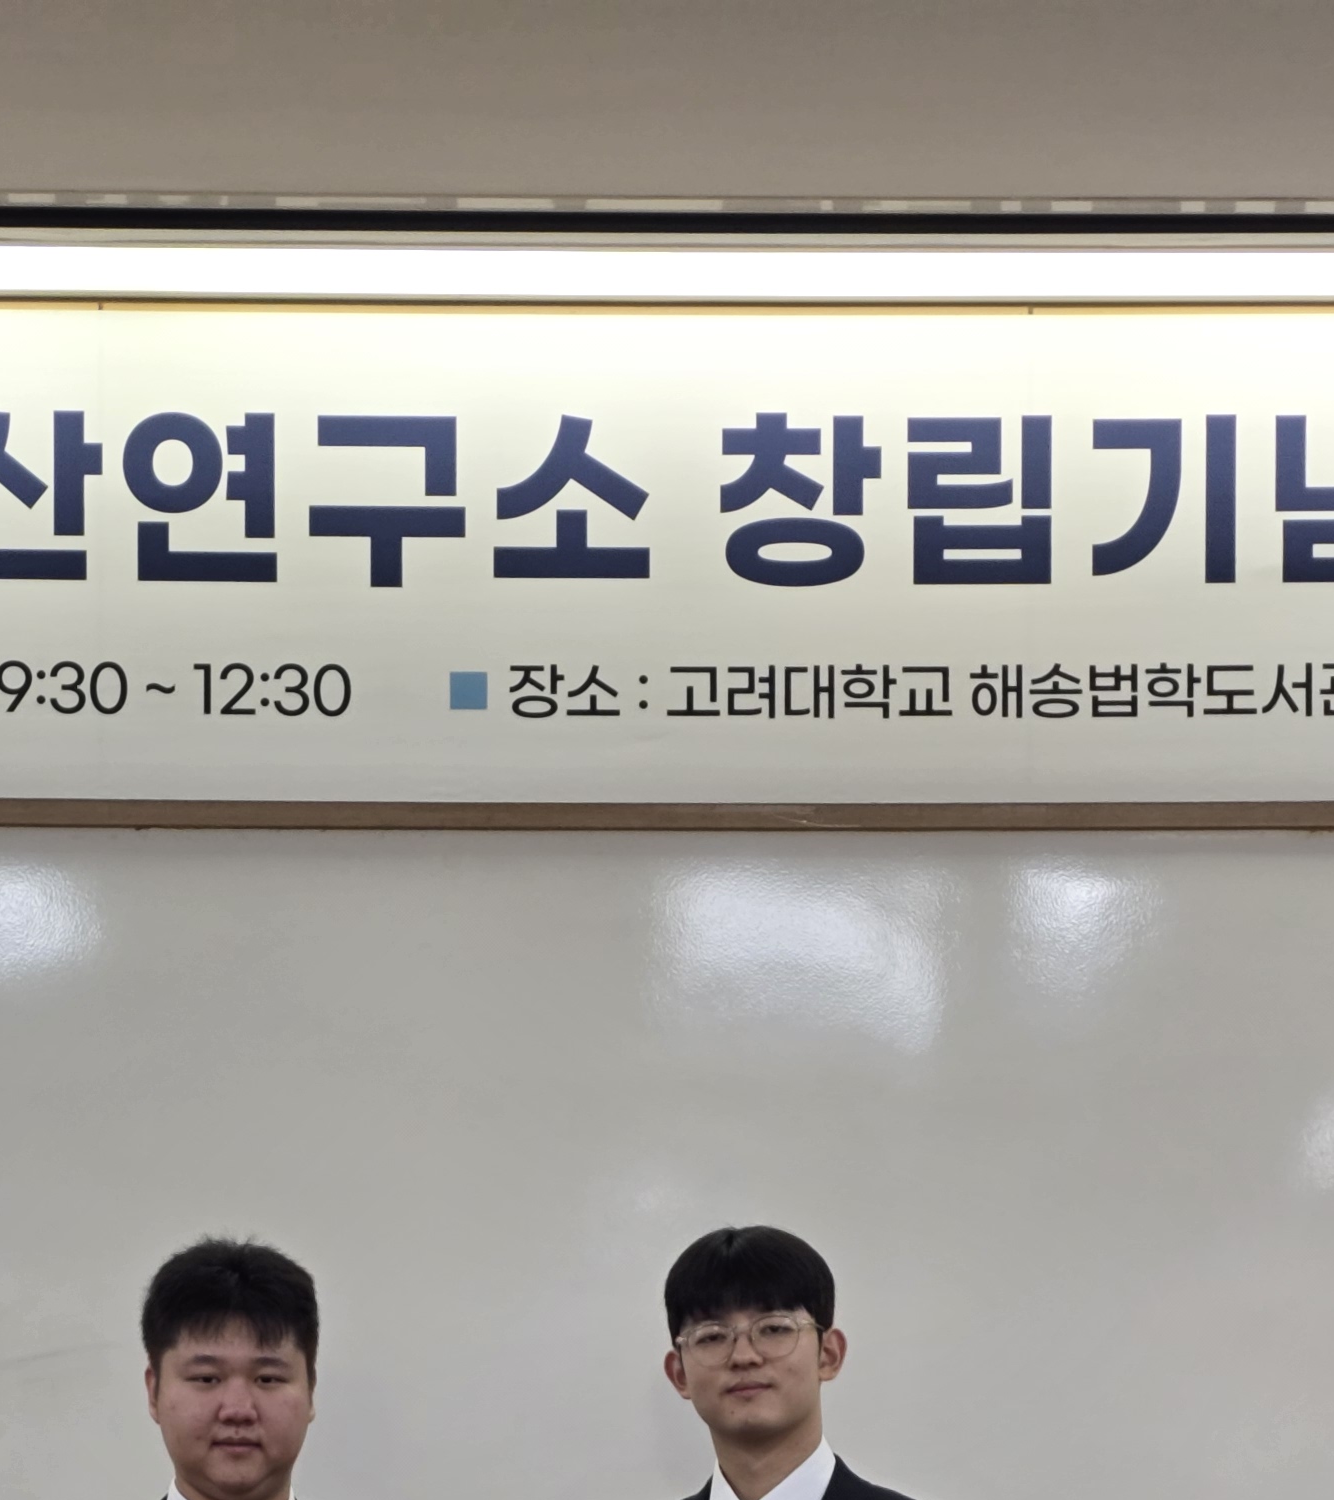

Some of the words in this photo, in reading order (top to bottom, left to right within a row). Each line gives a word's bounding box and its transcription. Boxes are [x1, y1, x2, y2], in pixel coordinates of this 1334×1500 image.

[192, 661, 353, 719] 12:30
[508, 662, 622, 720] 장소
[665, 662, 954, 721] 고려대학교
